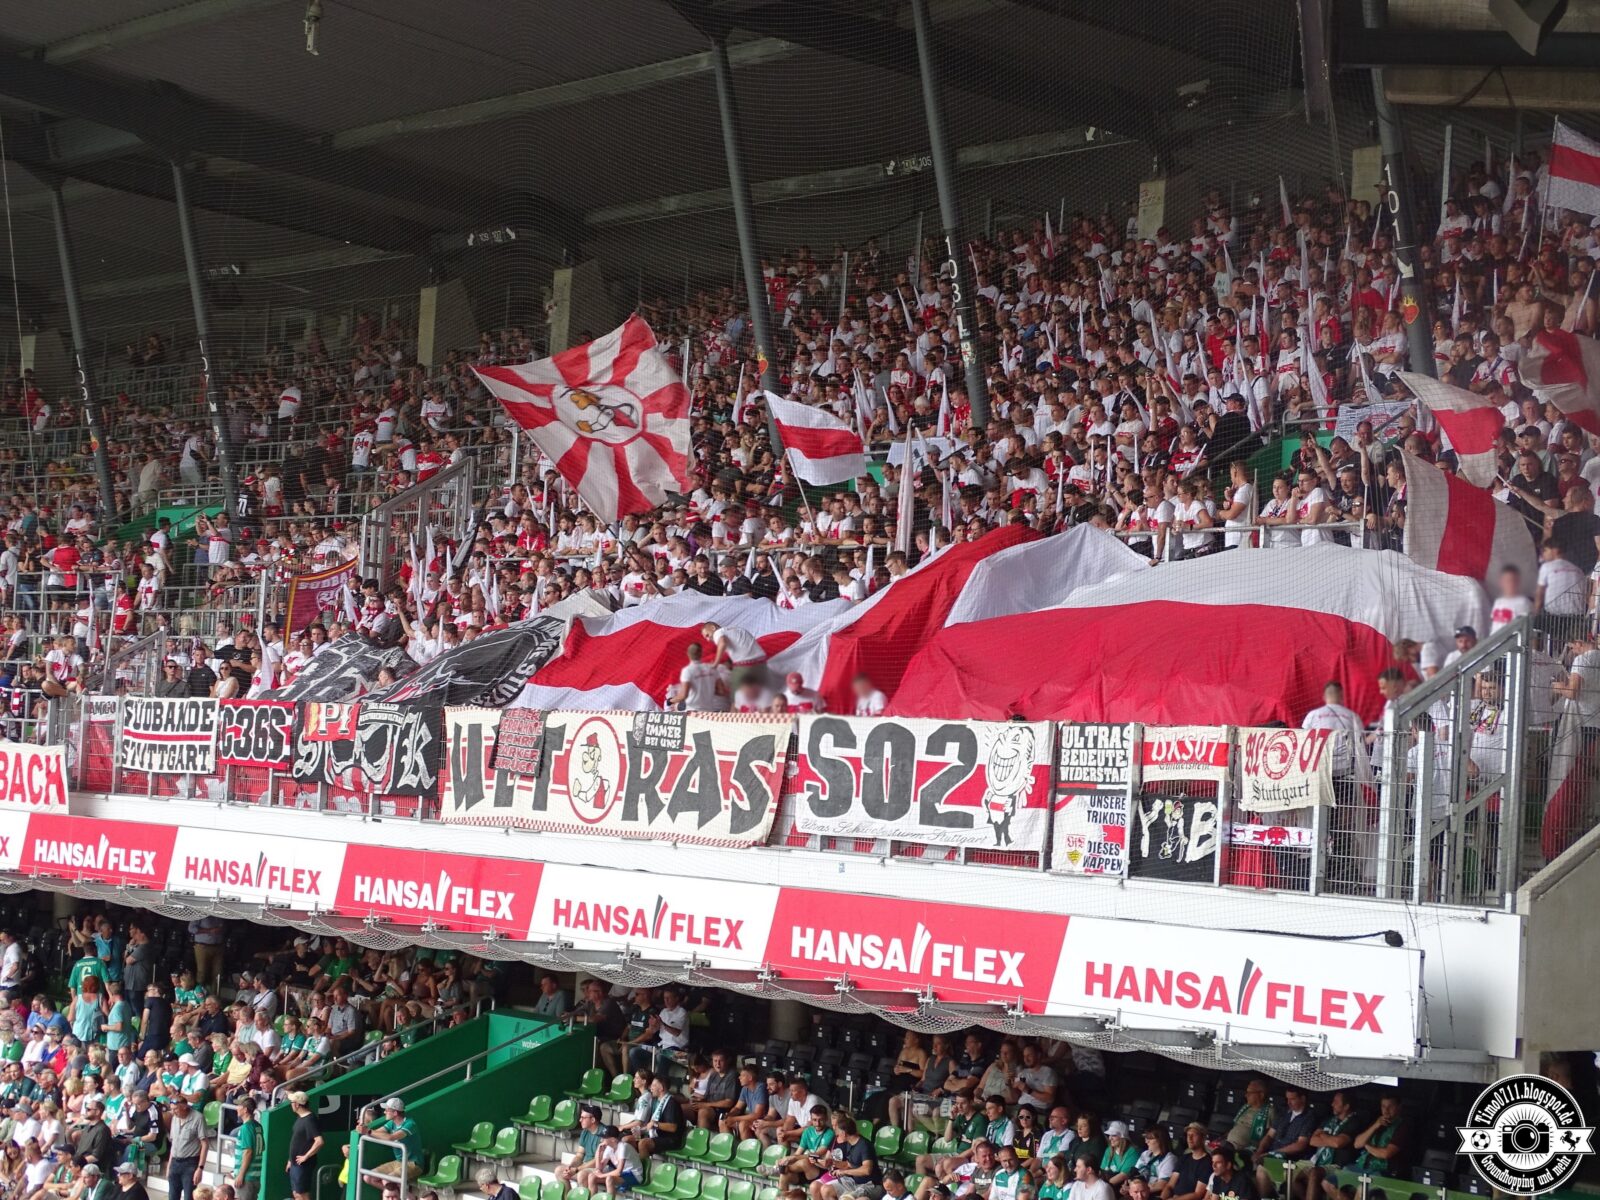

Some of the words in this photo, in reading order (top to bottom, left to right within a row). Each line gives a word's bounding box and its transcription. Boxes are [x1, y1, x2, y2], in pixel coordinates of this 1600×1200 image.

[1384, 162, 1401, 242] 101
[944, 235, 962, 303] 103
[648, 713, 661, 723] DU
[663, 714, 683, 725] BIST
[646, 723, 681, 739] IMMER
[645, 736, 658, 746] BEI
[660, 738, 681, 749] UNS!
[122, 739, 210, 771] STUTTGART
[1061, 748, 1128, 767] BEDEUTE
[1251, 778, 1310, 806] Stuttgart
[1090, 795, 1126, 810] UNSERE
[1087, 810, 1126, 826] TRIKOTS
[1088, 840, 1121, 856] DIESES
[1083, 855, 1123, 871] WAPPEN
